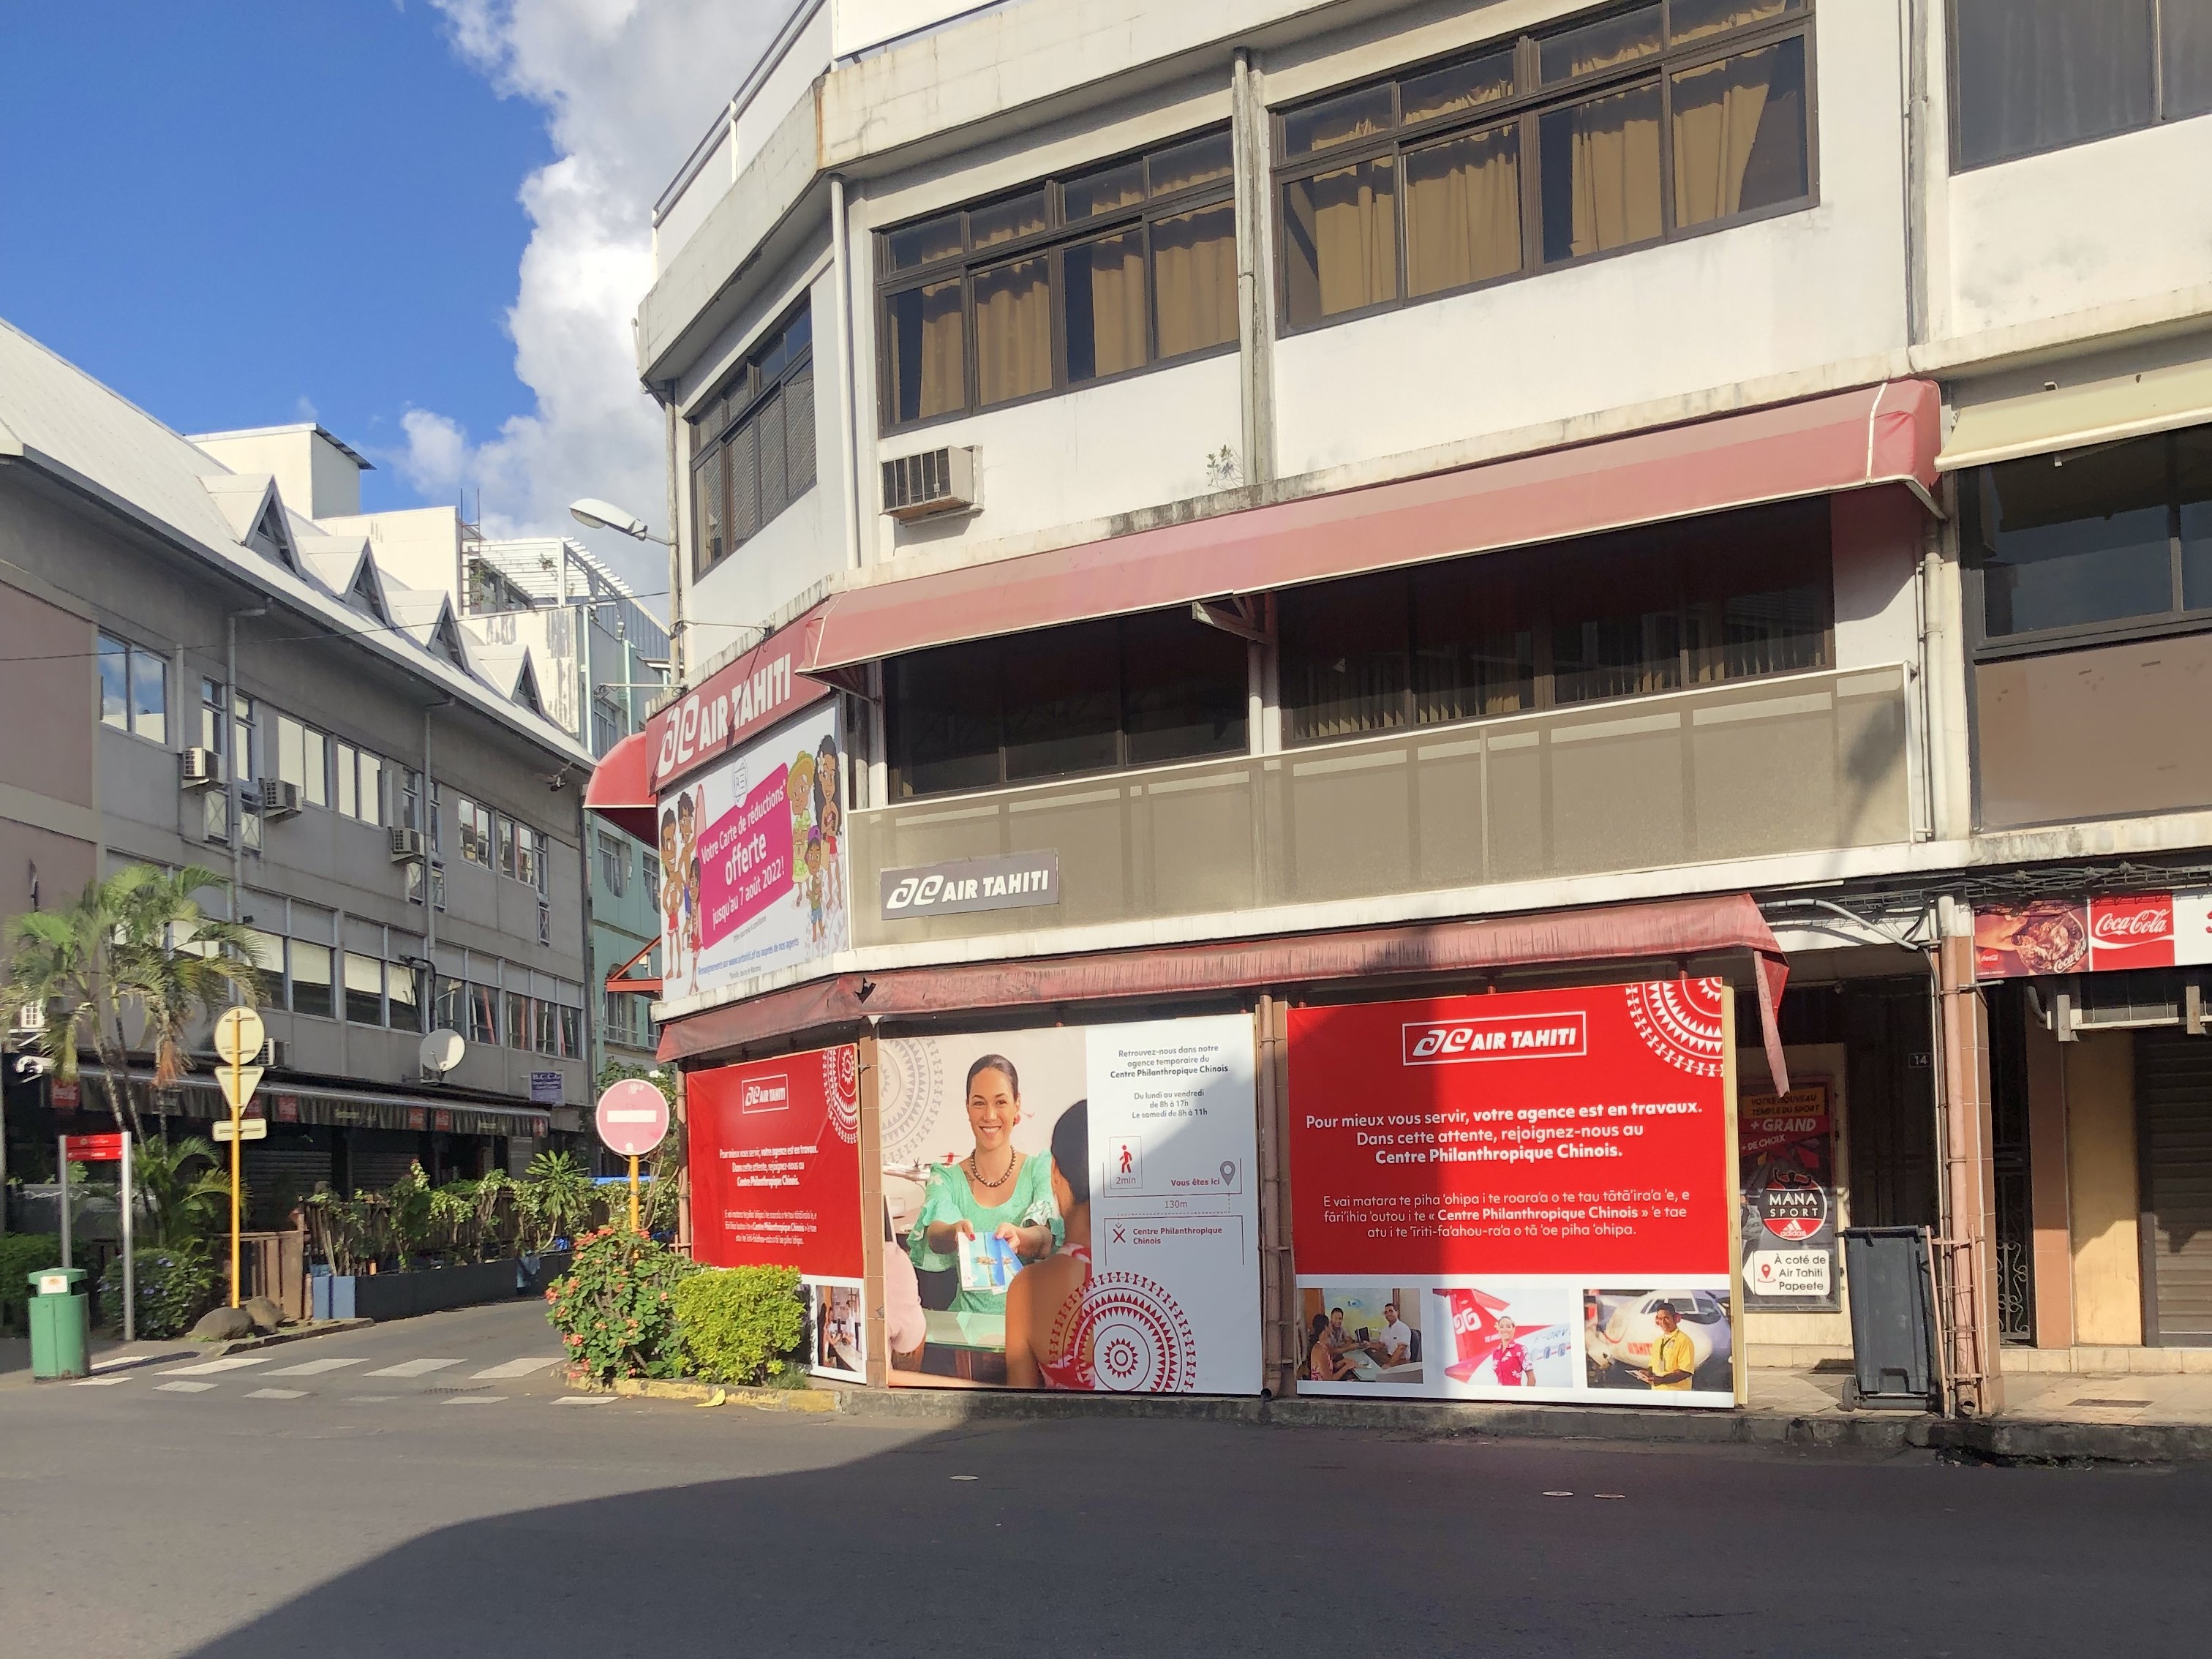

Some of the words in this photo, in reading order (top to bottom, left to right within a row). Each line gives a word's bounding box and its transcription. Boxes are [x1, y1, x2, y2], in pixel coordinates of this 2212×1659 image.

[699, 695, 729, 752] AIR
[731, 652, 791, 730] TAHITI
[701, 841, 718, 865] Votre
[720, 825, 737, 850] Carte
[738, 815, 746, 835] de
[726, 832, 767, 886] offerte
[941, 879, 978, 903] AIR
[983, 870, 1049, 898] TAHITI
[712, 895, 739, 930] jusqu'au
[739, 887, 744, 906] 7
[745, 876, 761, 902] août
[2095, 908, 2171, 937] Coca-Cola
[1470, 1031, 1506, 1051] AIR
[1511, 1028, 1576, 1049] TAHITI
[1118, 1048, 1176, 1058] Retrouvez-nous
[1178, 1045, 1197, 1054] dans
[1198, 1045, 1219, 1053] notre
[1127, 1061, 1154, 1069] agence
[1156, 1057, 1198, 1066] temporaire
[1200, 1055, 1209, 1063] du
[1137, 1067, 1198, 1077] Philanthropique
[1200, 1064, 1228, 1073] Chinois
[1174, 1089, 1204, 1097] vendredi
[1141, 1110, 1167, 1118] samedi
[1306, 1115, 1339, 1129] Pour
[1342, 1113, 1384, 1127] mieux
[1388, 1114, 1421, 1125] vous
[1424, 1109, 1470, 1126] servir,
[1472, 1109, 1514, 1122] votre
[1516, 1106, 1576, 1124] agence
[1579, 1104, 1604, 1118] est
[1607, 1105, 1628, 1116] en
[1630, 1101, 1703, 1116] travaux.
[1794, 1105, 1820, 1113] SPORT
[1762, 1118, 1816, 1132] GRAND
[1357, 1132, 1394, 1146] Dans
[1397, 1132, 1434, 1145] cette
[1437, 1129, 1497, 1146] attente,
[1501, 1125, 1620, 1144] rejoignez-nous
[1622, 1124, 1644, 1136] au
[1748, 1141, 1758, 1151] DE
[1758, 1134, 1786, 1148] CHOIX
[1375, 1150, 1426, 1165] Centre
[1429, 1145, 1554, 1164] Philanthropique
[1557, 1142, 1623, 1159] Chinois.
[1116, 1176, 1136, 1185] 2min
[1165, 1200, 1188, 1208] 130m
[1323, 1196, 1331, 1207] E
[1333, 1196, 1350, 1207] vai
[1353, 1196, 1396, 1207] matara
[1399, 1196, 1411, 1206] te
[1414, 1194, 1440, 1208] piha
[1482, 1192, 1486, 1203] i
[1488, 1193, 1500, 1203] te
[1551, 1195, 1560, 1203] o
[1562, 1192, 1575, 1203] te
[1578, 1192, 1600, 1203] tau
[1682, 1191, 1690, 1200] e
[1769, 1192, 1818, 1205] MANA
[1408, 1211, 1411, 1222] i
[1414, 1211, 1426, 1221] te
[1437, 1209, 1480, 1221] Centre
[1483, 1207, 1586, 1222] Philanthropique
[1588, 1205, 1639, 1219] Chinois
[1664, 1207, 1687, 1218] tae
[1770, 1208, 1818, 1217] SPORT
[1133, 1227, 1159, 1235] Centre
[1160, 1227, 1223, 1235] Philanthropique
[1367, 1227, 1387, 1238] atu
[1390, 1226, 1393, 1237] i
[1396, 1227, 1407, 1237] te
[1513, 1228, 1521, 1236] o
[1524, 1224, 1538, 1236] tā
[1561, 1222, 1590, 1238] piha
[1774, 1253, 1782, 1264] À
[1786, 1254, 1810, 1264] coté
[1813, 1255, 1826, 1264] de
[1778, 1268, 1794, 1277] Air
[1796, 1268, 1823, 1277] Tahiti
[1779, 1282, 1824, 1292] Papeete
